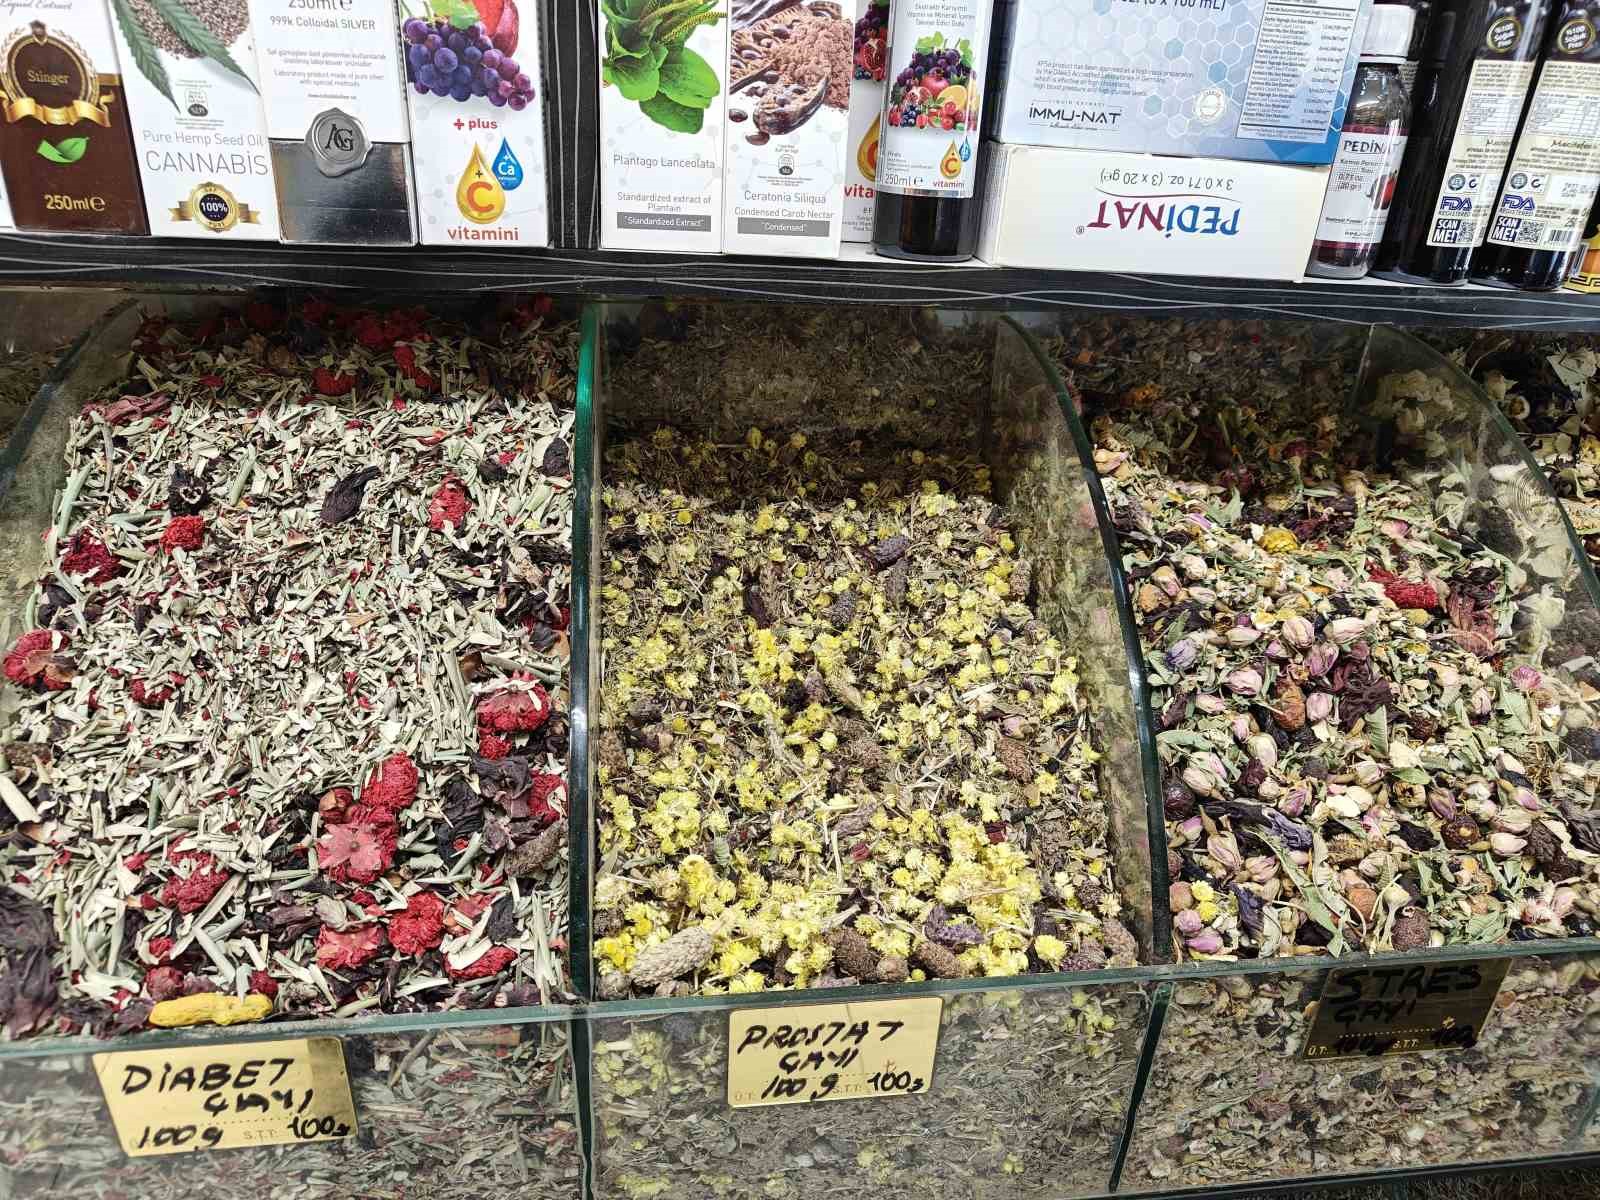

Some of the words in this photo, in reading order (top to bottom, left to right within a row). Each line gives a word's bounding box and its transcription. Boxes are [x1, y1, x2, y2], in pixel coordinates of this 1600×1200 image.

[296, 16, 339, 29] Colloidal
[341, 19, 376, 31] SILVER
[469, 117, 498, 130] plus
[143, 130, 172, 144] Pure
[175, 131, 211, 147] Hemp
[214, 133, 244, 147] Seed
[247, 134, 263, 147] Oil
[498, 160, 515, 176] Ca
[613, 154, 658, 169] Plantago
[661, 156, 716, 169] Lanceolata
[1123, 172, 1138, 185] 20
[1226, 178, 1234, 191] 3
[467, 181, 495, 213] C
[617, 191, 672, 203] Standardized
[744, 190, 792, 203] Ceratonia
[793, 192, 826, 206] Siliqua
[844, 184, 874, 199] vita
[201, 201, 229, 214] 100%
[1440, 196, 1472, 211] FDA
[1501, 194, 1535, 211] FDA
[734, 206, 780, 218] Condensed
[781, 208, 806, 219] Carob
[807, 209, 835, 219] Nectar
[1437, 219, 1459, 230] SCAN
[1497, 216, 1519, 228] SCAN
[447, 226, 519, 242] vitamini
[1434, 229, 1456, 243] ME!
[1493, 226, 1516, 242] ME!
[1329, 965, 1483, 1005] STRES
